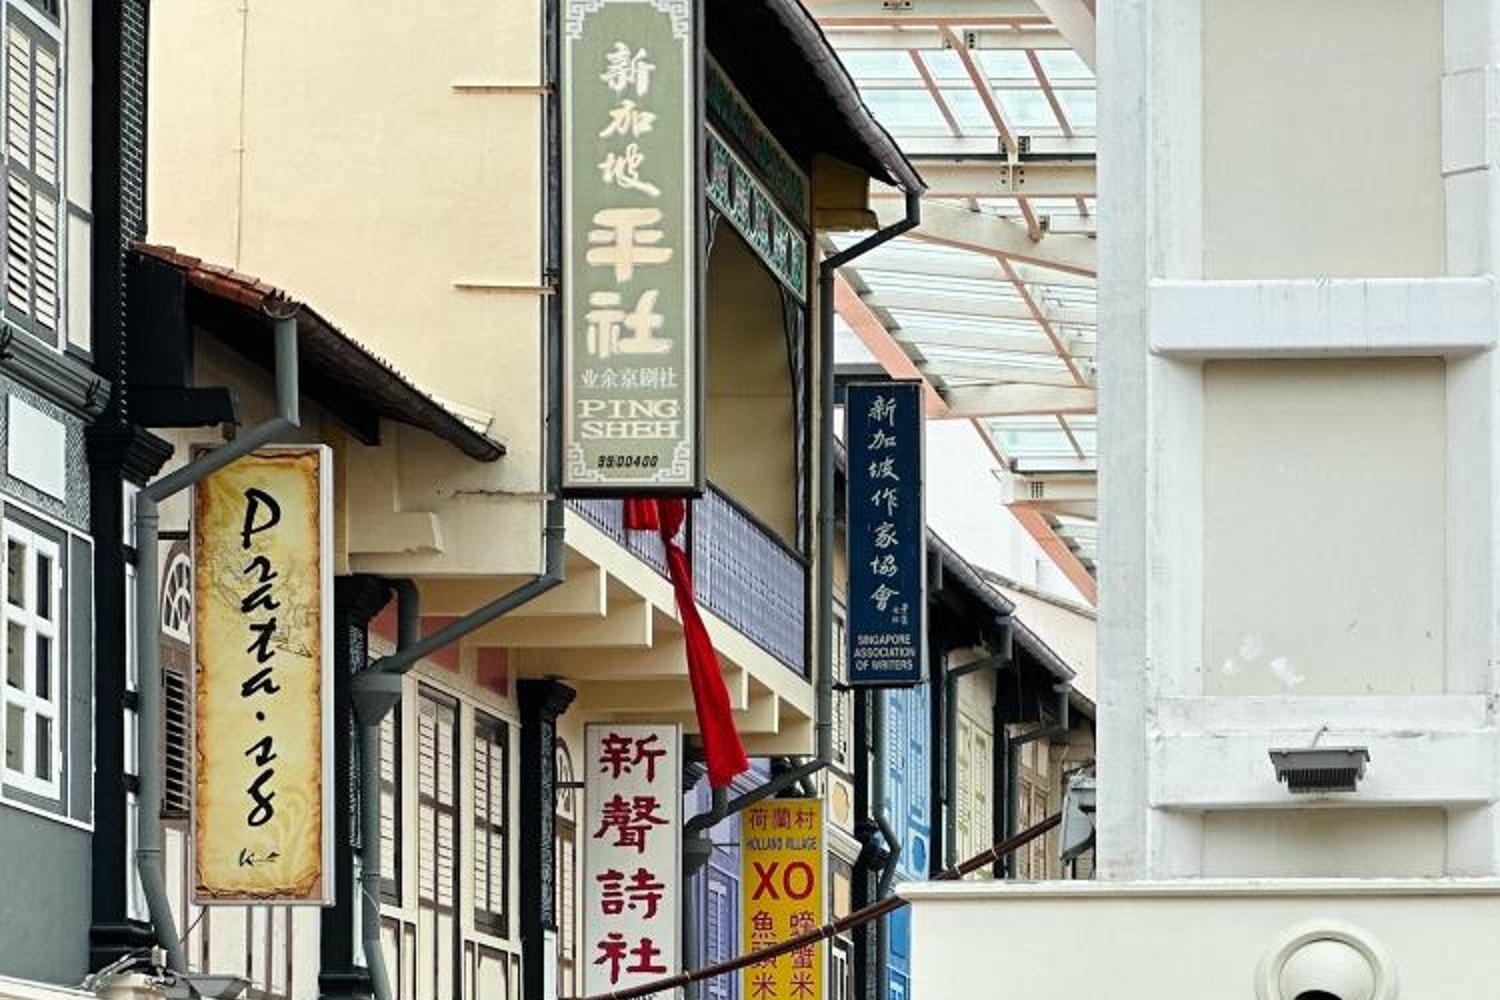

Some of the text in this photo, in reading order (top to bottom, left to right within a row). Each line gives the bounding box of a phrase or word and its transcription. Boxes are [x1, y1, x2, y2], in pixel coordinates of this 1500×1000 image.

[577, 399, 680, 419] PING
[580, 420, 680, 438] SHEH
[867, 395, 899, 611] 新加坡作家協會
[857, 634, 911, 645] SINGAPORE
[853, 647, 916, 658] ASSOCIATION
[856, 660, 913, 671] OF WRITERS
[593, 733, 669, 985] 新聲詩社
[752, 861, 815, 900] XO
